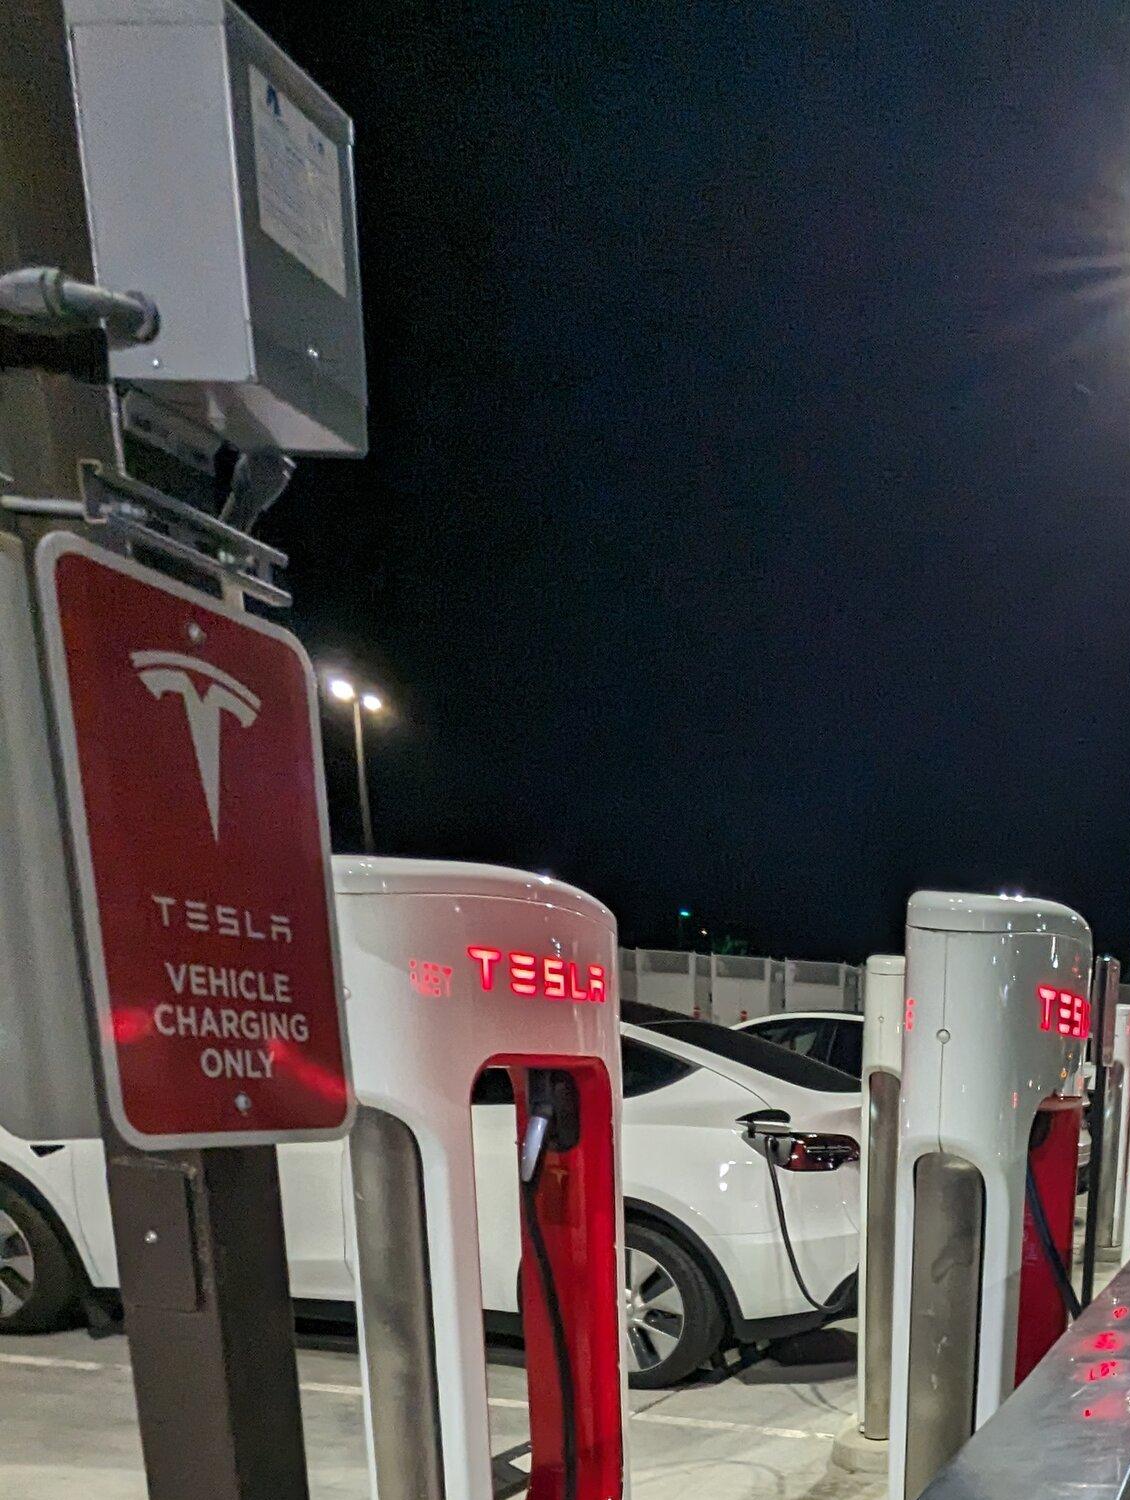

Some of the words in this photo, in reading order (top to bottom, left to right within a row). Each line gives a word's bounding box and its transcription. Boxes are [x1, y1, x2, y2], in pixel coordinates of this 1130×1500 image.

[152, 895, 292, 943] TESLA
[164, 961, 293, 1003] VEHICLE
[467, 947, 606, 1002] TESLA
[154, 1003, 309, 1042] CHARGING
[200, 1048, 275, 1079] ONLY
